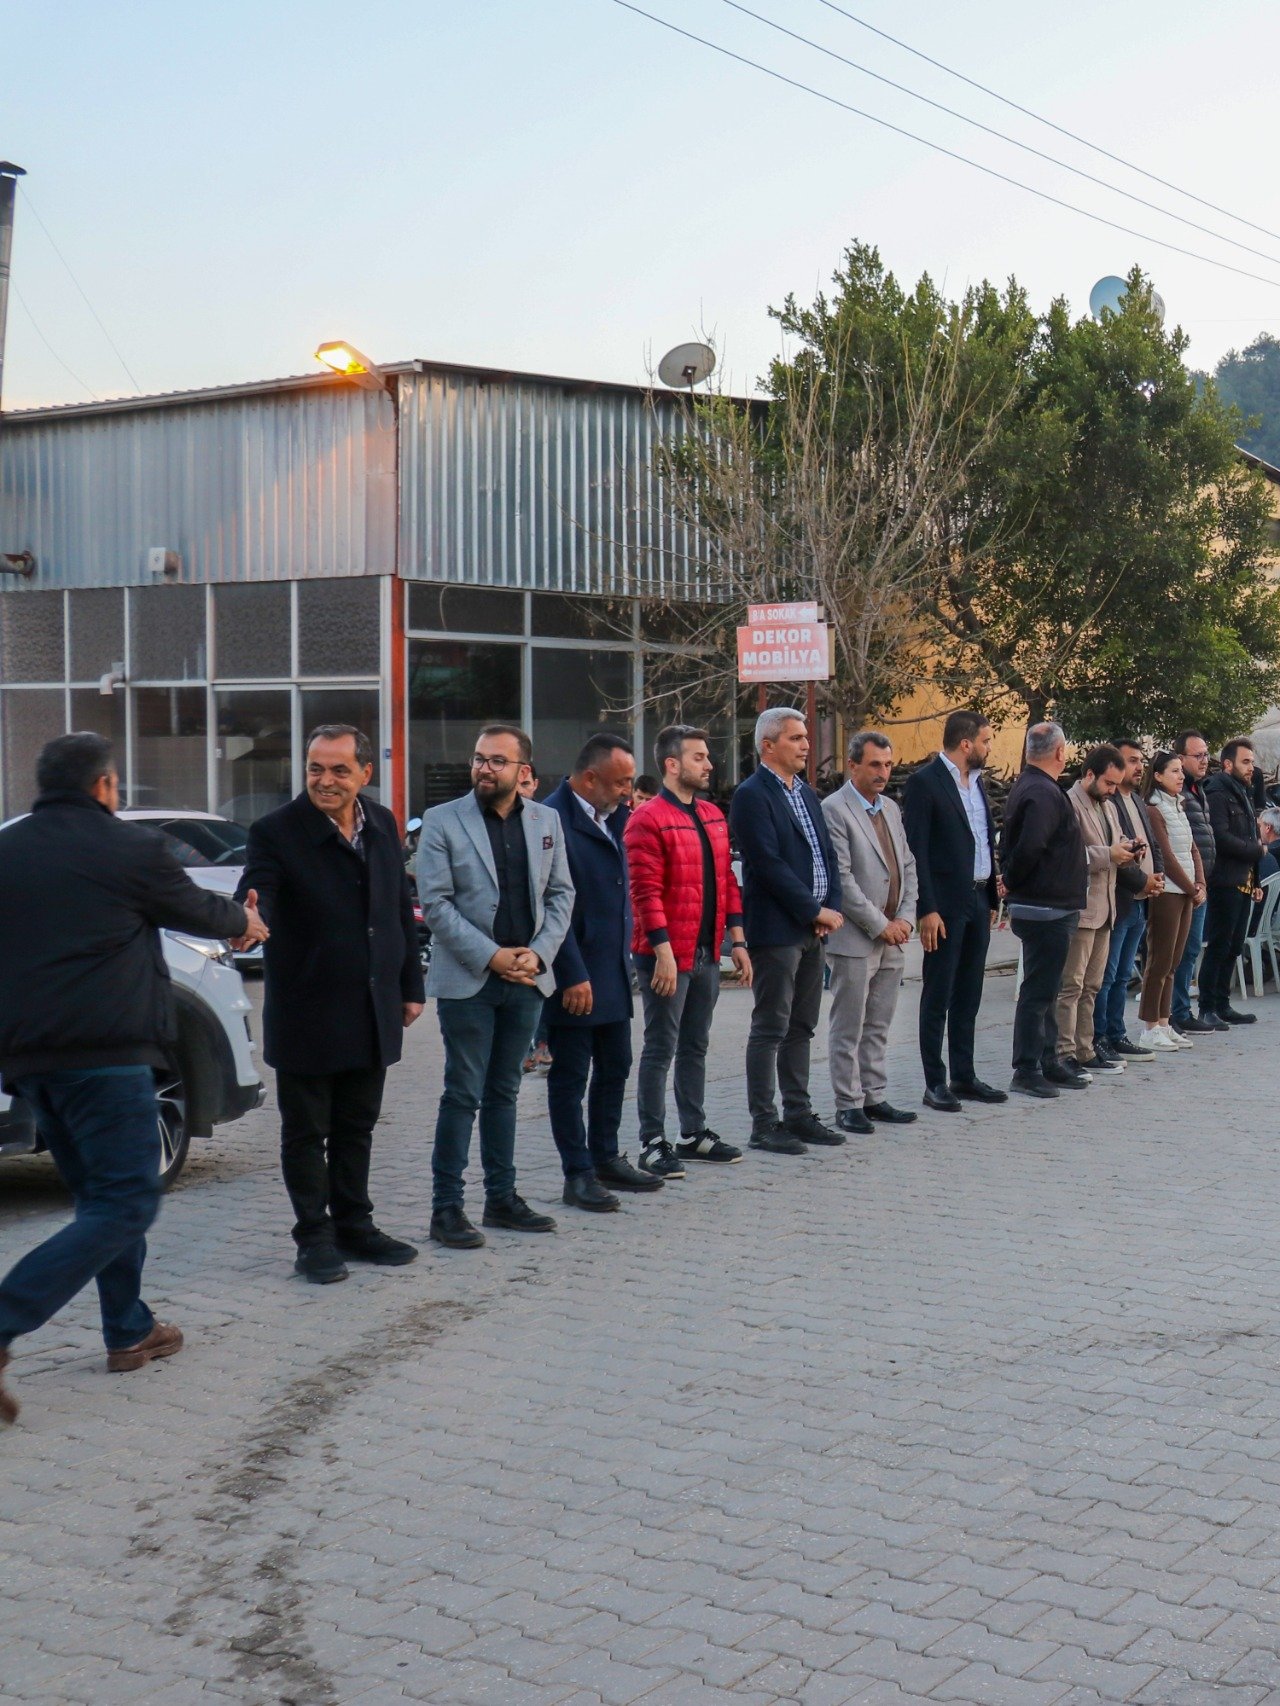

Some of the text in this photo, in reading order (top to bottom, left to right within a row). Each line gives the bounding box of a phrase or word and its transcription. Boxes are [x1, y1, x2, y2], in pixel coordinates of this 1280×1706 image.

[767, 607, 797, 620] SOKAK
[752, 628, 812, 645] DEKOR
[742, 645, 821, 665] MOBİLYA
